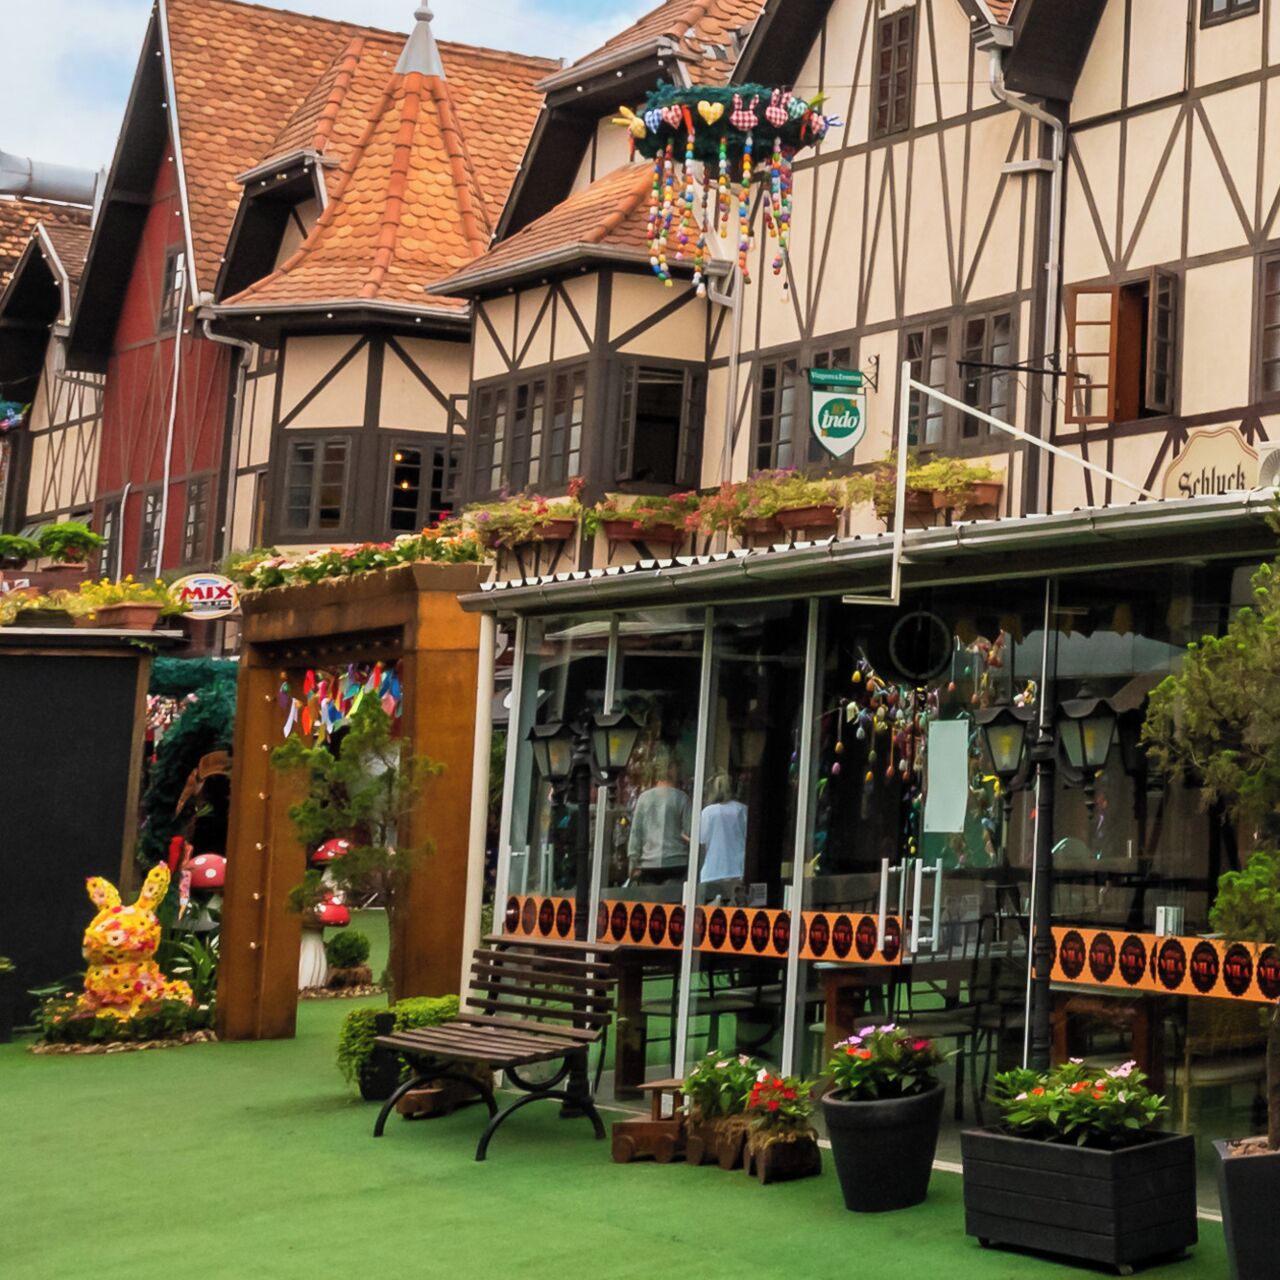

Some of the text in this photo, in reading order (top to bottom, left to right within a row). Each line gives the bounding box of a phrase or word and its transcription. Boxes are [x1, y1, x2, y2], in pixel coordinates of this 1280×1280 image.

[822, 410, 858, 428] indo
[1178, 462, 1245, 498] Schluck
[180, 584, 233, 600] MIX
